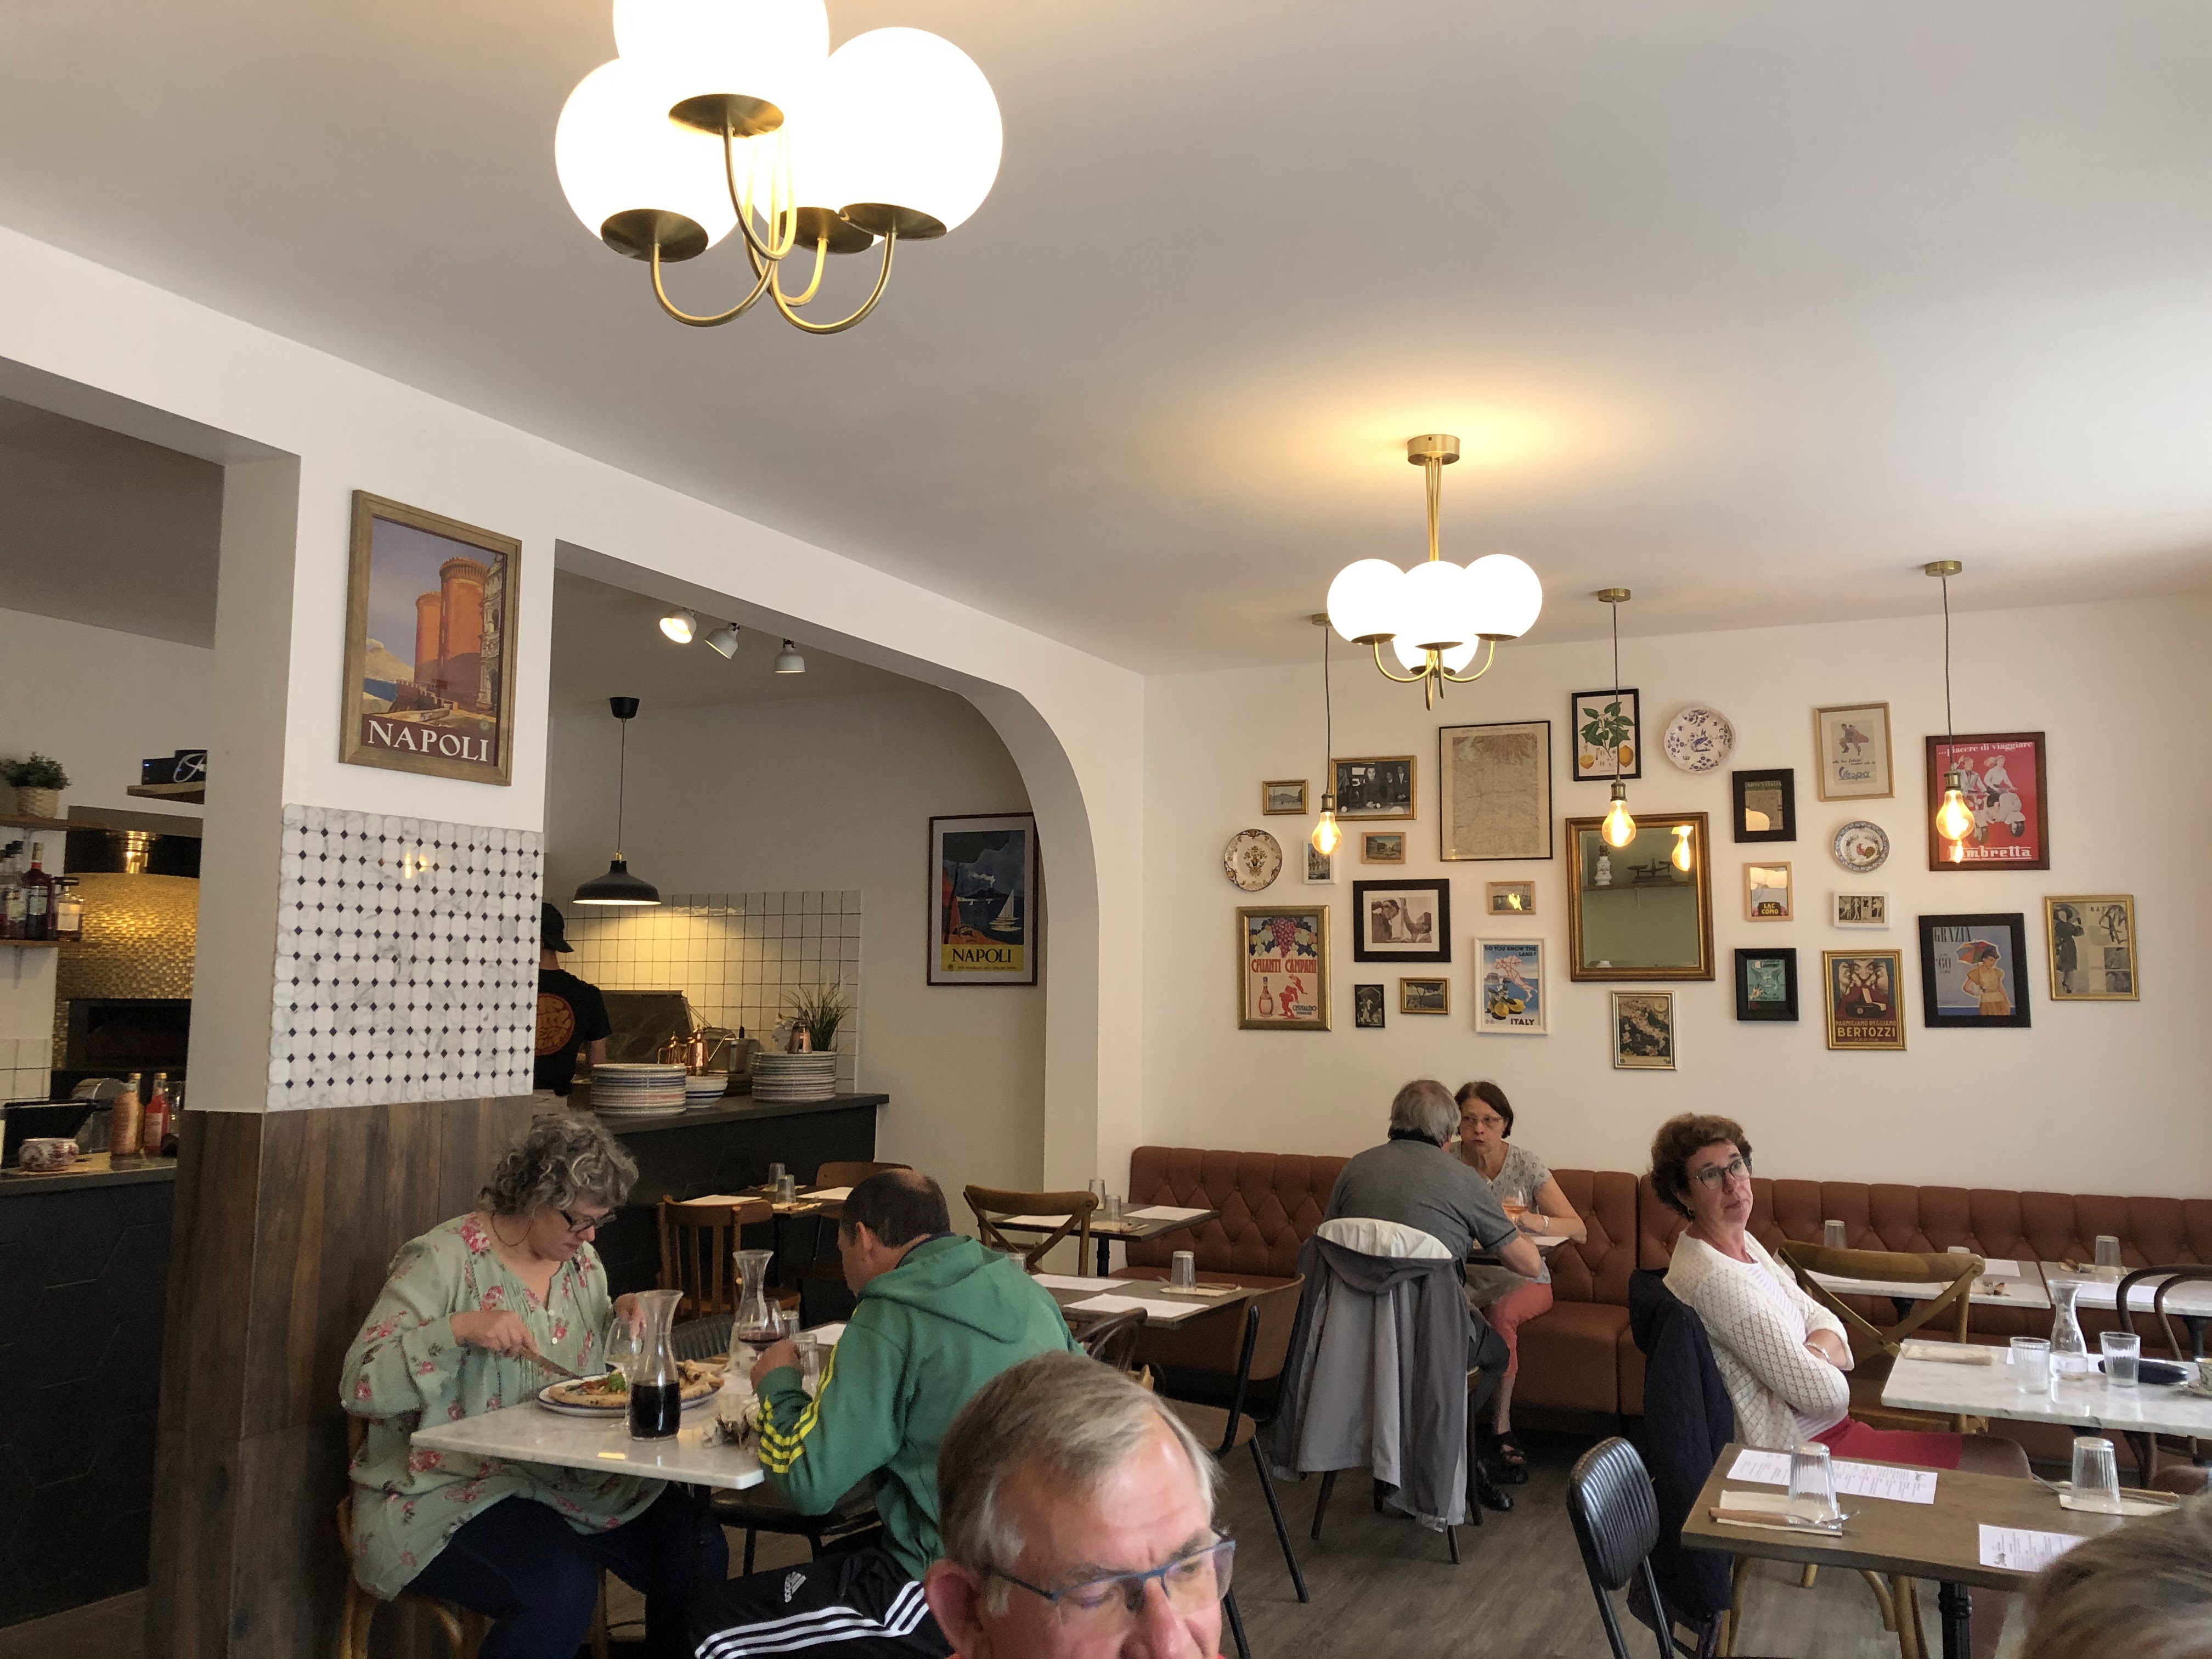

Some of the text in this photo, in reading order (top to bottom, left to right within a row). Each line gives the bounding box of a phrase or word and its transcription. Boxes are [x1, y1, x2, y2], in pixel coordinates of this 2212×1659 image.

[368, 720, 489, 762] NAPOLI
[1992, 741, 2033, 752] viaggiare
[1838, 766, 1870, 781] Vespa
[1948, 845, 2032, 861] Lmbretta
[1934, 927, 1971, 942] GRAZIA
[952, 948, 1012, 963] NAPOLI
[1251, 958, 1282, 973] CHIANTI
[1837, 1026, 1896, 1037] BERTOZZI
